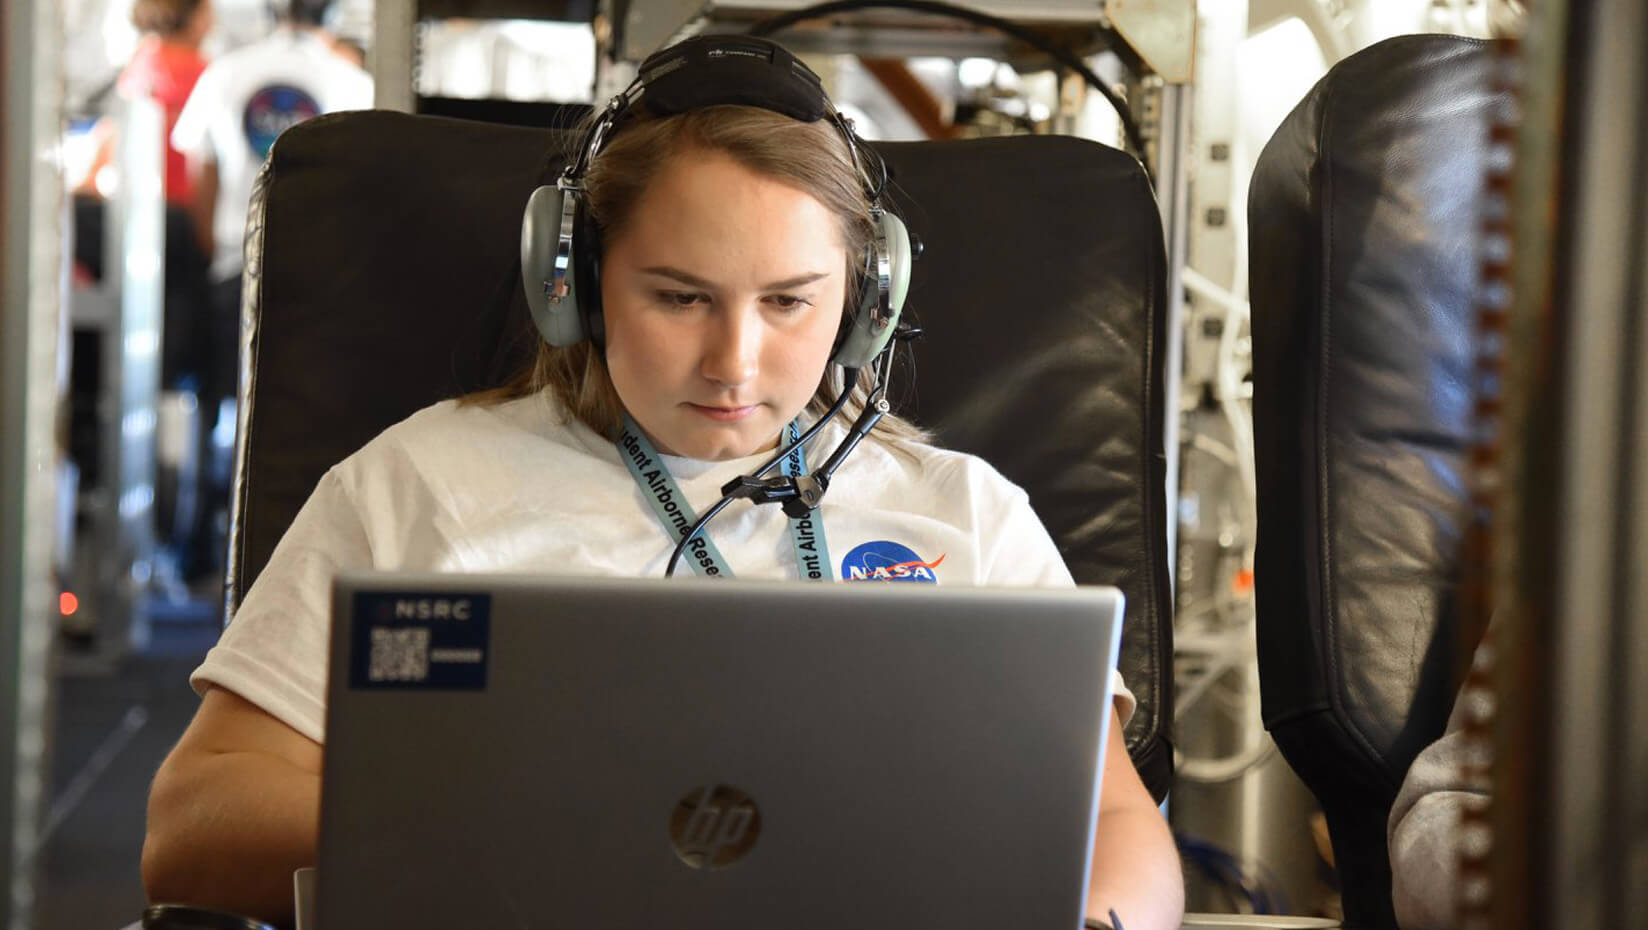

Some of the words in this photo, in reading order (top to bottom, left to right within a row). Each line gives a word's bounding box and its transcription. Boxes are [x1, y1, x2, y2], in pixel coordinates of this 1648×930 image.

[643, 470, 691, 536] Airborne
[688, 537, 723, 577] Rese
[849, 565, 932, 580] NASA
[396, 600, 472, 620] NSRC
[683, 784, 753, 871] hp
